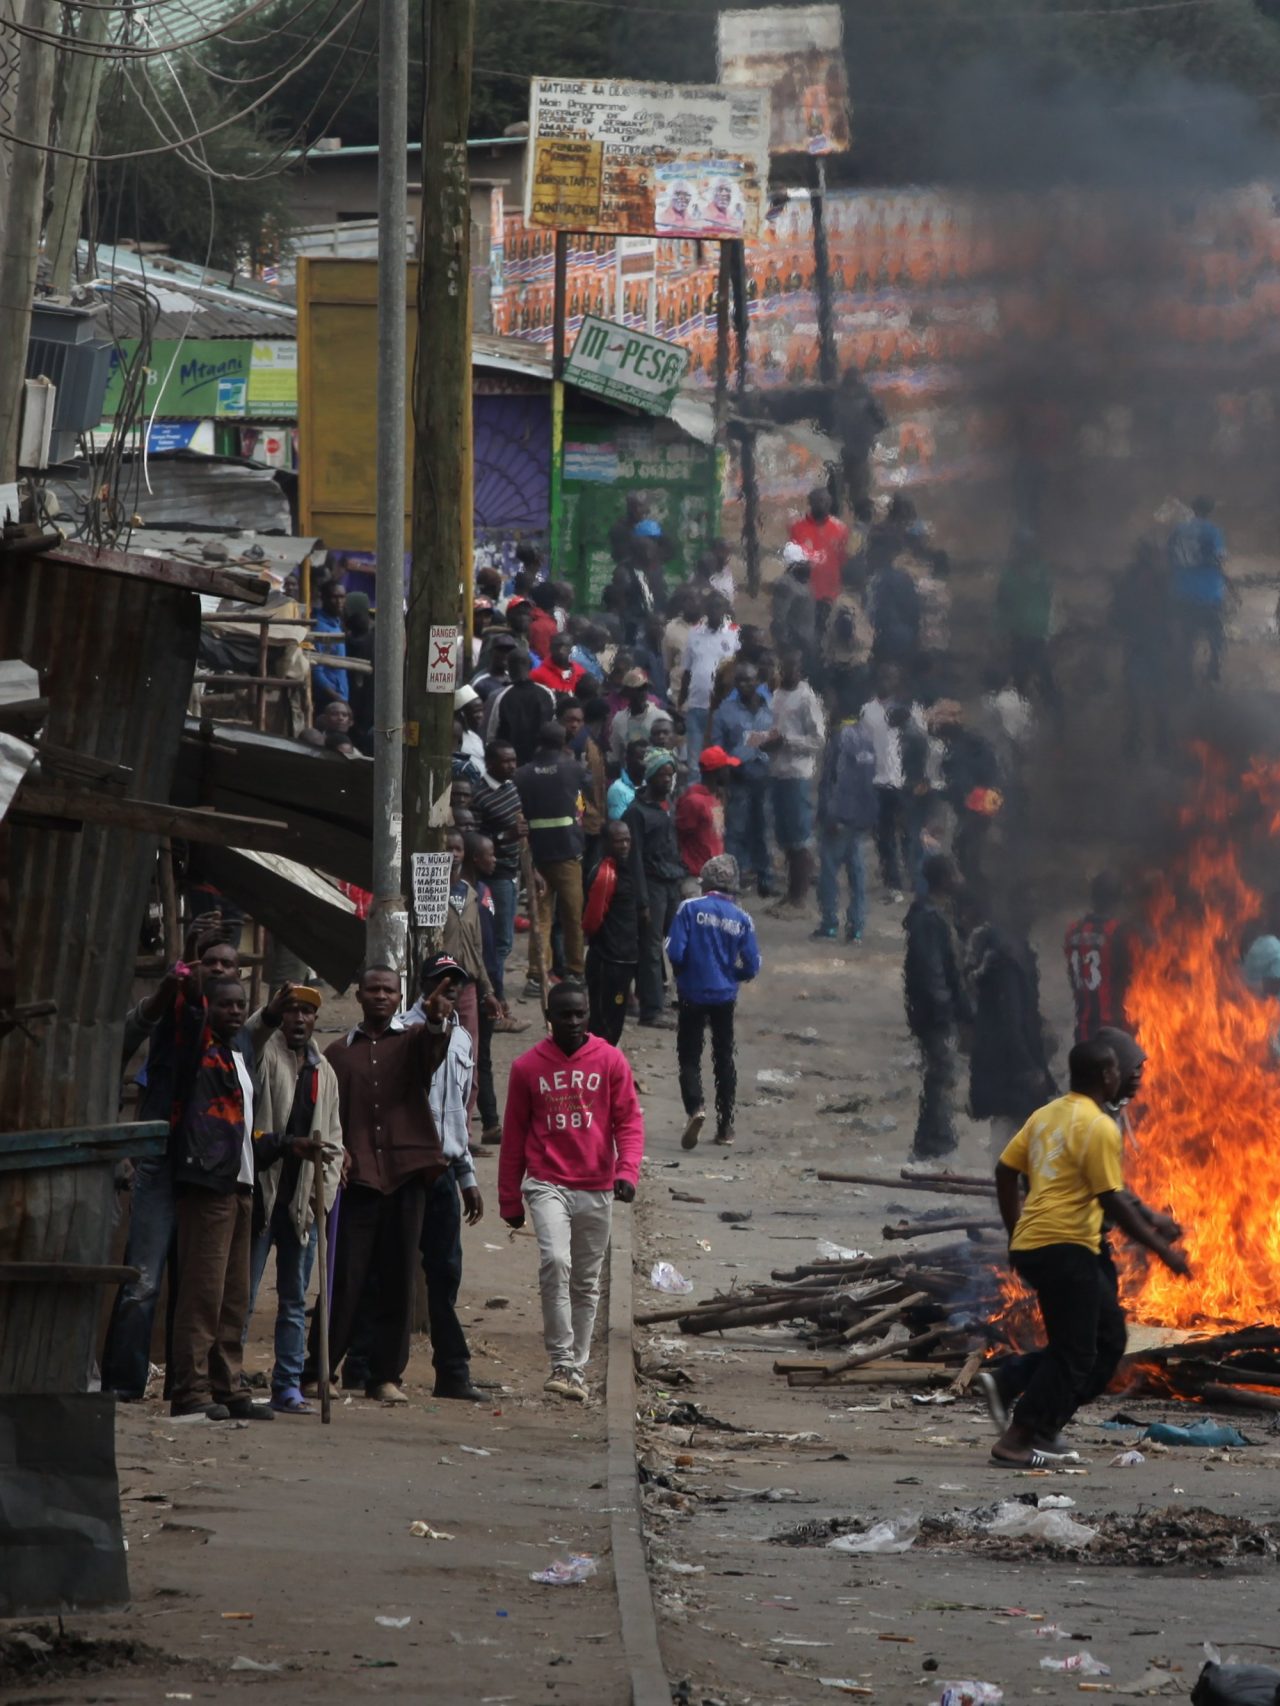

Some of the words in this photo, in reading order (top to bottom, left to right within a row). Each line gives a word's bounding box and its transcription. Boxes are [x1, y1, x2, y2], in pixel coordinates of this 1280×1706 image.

[540, 83, 587, 95] MATHARE
[592, 85, 605, 95] 4A
[539, 98, 561, 107] Main
[181, 355, 243, 385] Mtaani
[431, 628, 457, 638] DANGER
[430, 672, 454, 683] HATARI
[418, 904, 435, 912] KINGA
[429, 914, 440, 923] 871
[538, 1070, 601, 1094] AERO
[547, 1111, 593, 1130] 1987
